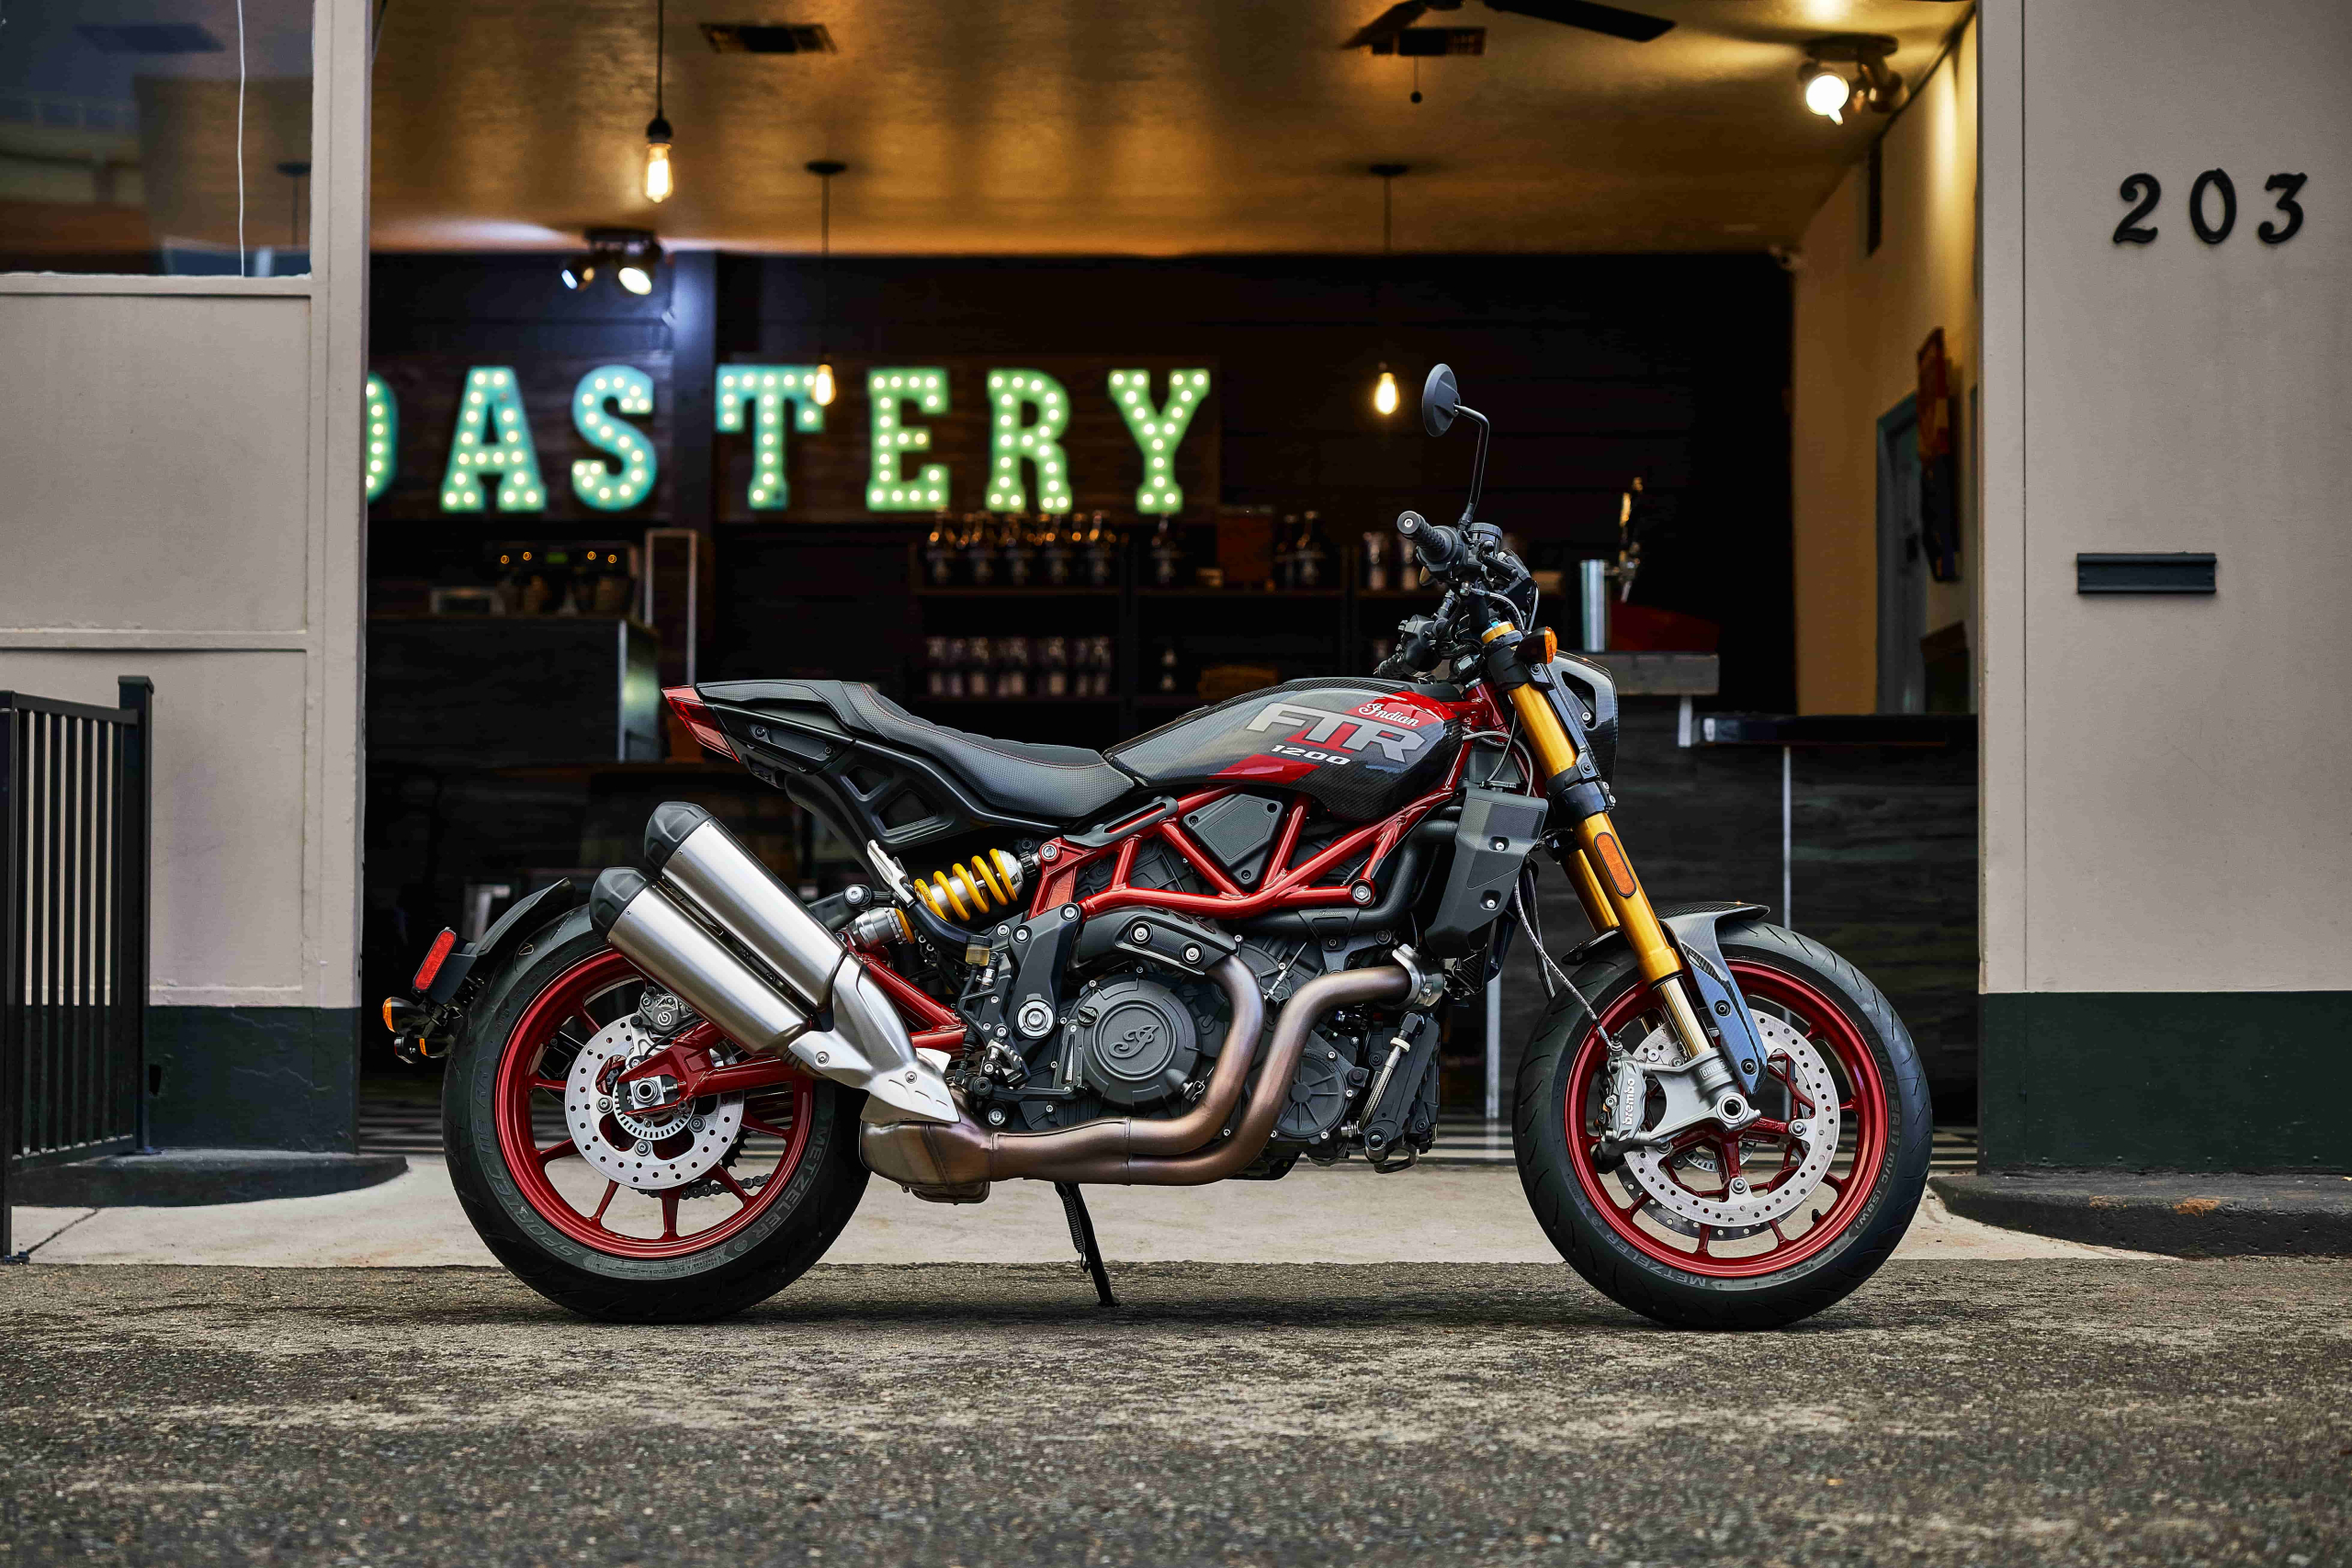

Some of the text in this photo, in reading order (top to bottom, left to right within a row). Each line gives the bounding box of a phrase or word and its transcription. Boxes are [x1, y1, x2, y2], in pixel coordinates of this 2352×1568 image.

[2113, 167, 2308, 245] 203
[1245, 702, 1428, 764] FTR
[1358, 702, 1420, 728] Indian
[1271, 744, 1351, 765] 1200
[1623, 1077, 1635, 1126] brembo
[752, 1129, 828, 1238] METZELER
[1606, 1231, 1707, 1287] METZELER
